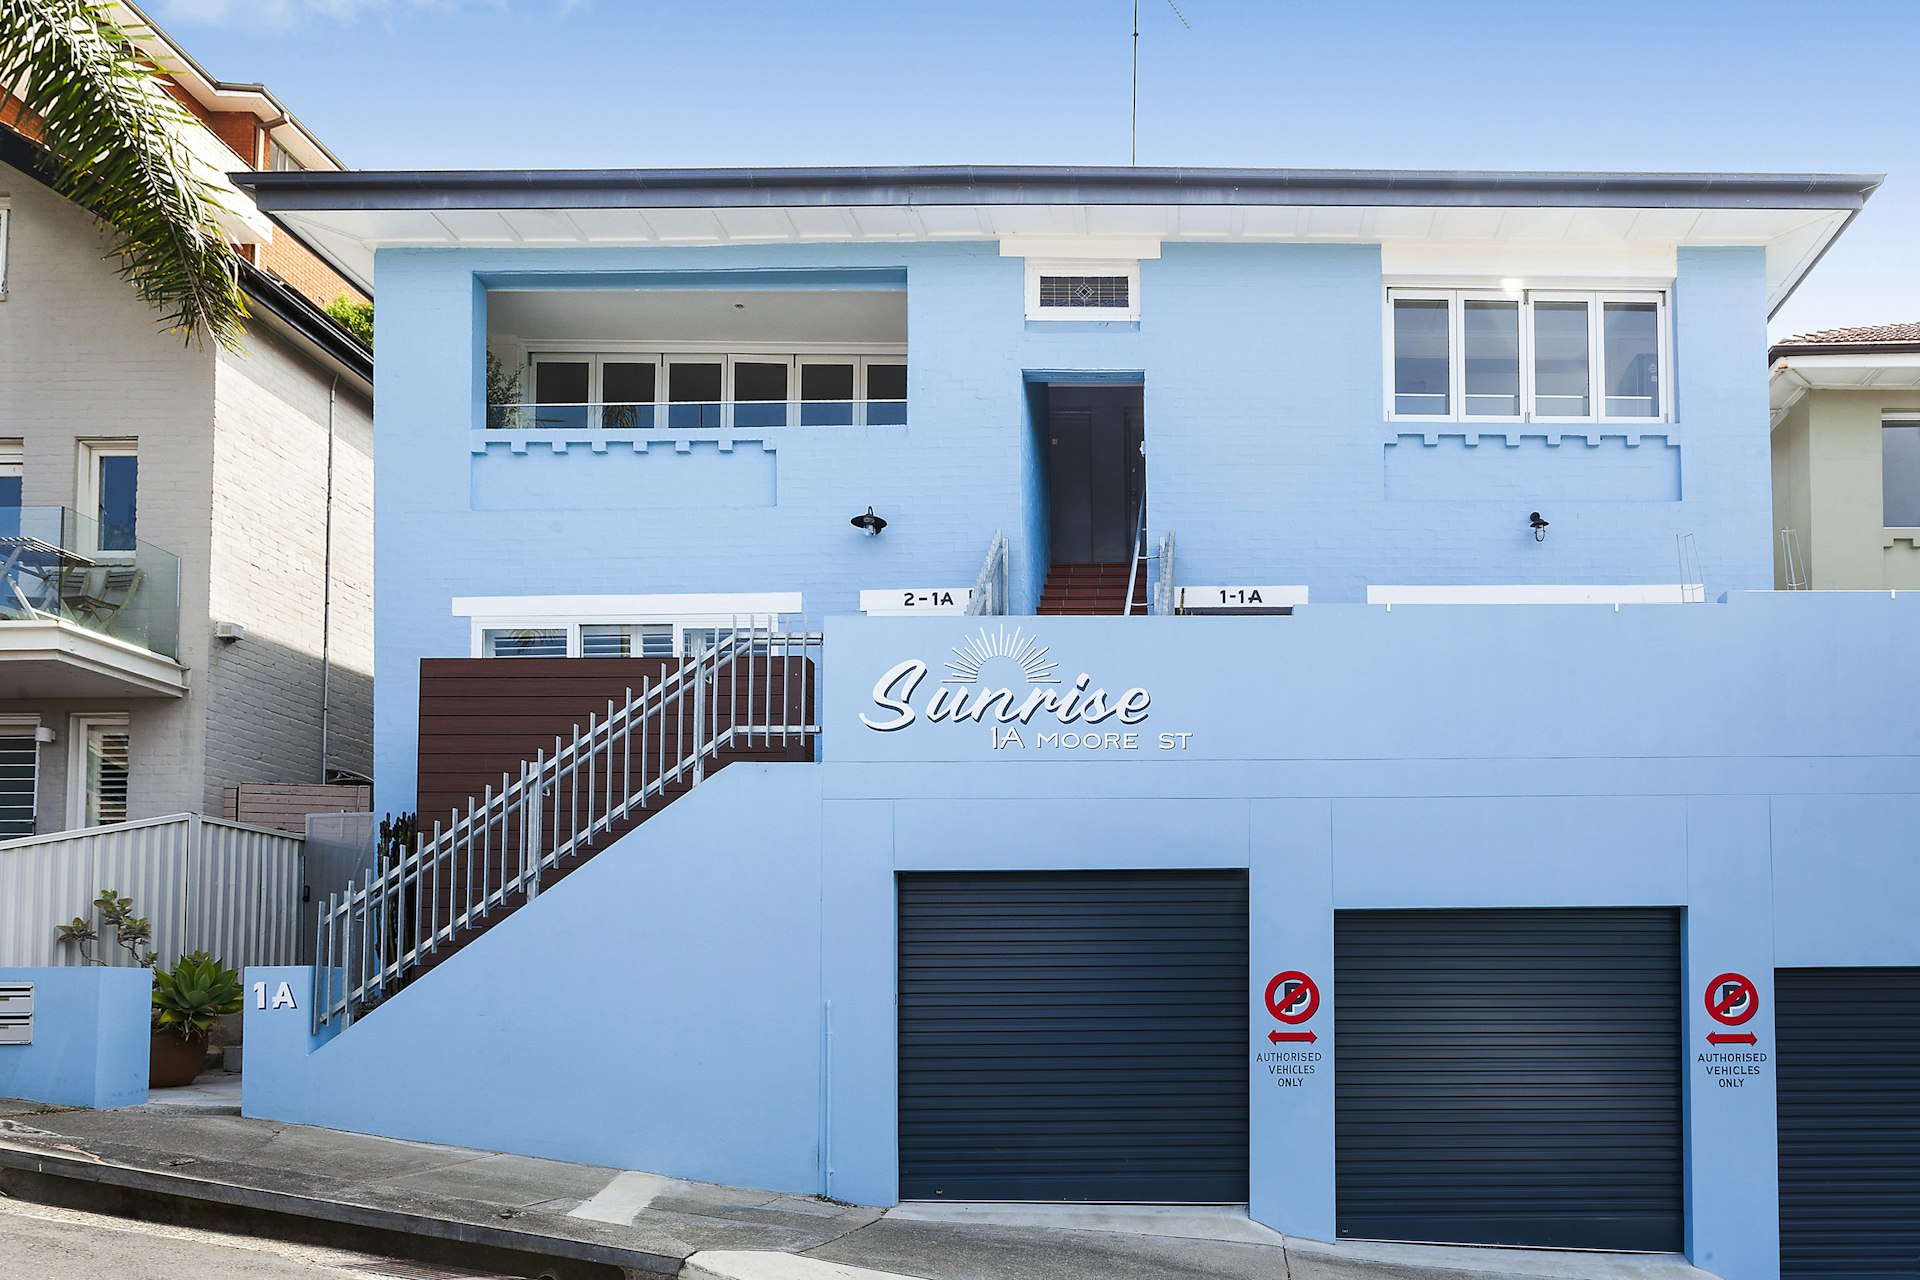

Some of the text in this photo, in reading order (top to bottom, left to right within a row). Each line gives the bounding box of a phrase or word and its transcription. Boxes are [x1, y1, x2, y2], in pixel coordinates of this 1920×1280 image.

[903, 591, 954, 606] 2-1A
[1219, 589, 1263, 604] 1-1A
[858, 658, 1152, 732] Sunrise
[990, 726, 1194, 750] 1A MOORE ST
[253, 981, 298, 1010] 1A
[1256, 1052, 1322, 1062] AUTHORISED
[1697, 1053, 1767, 1063] AUTHORISED
[1268, 1065, 1315, 1075] VEHICLES
[1706, 1066, 1760, 1075] VEHICLES
[1277, 1078, 1304, 1087] ONLY
[1718, 1078, 1745, 1088] ONLY
